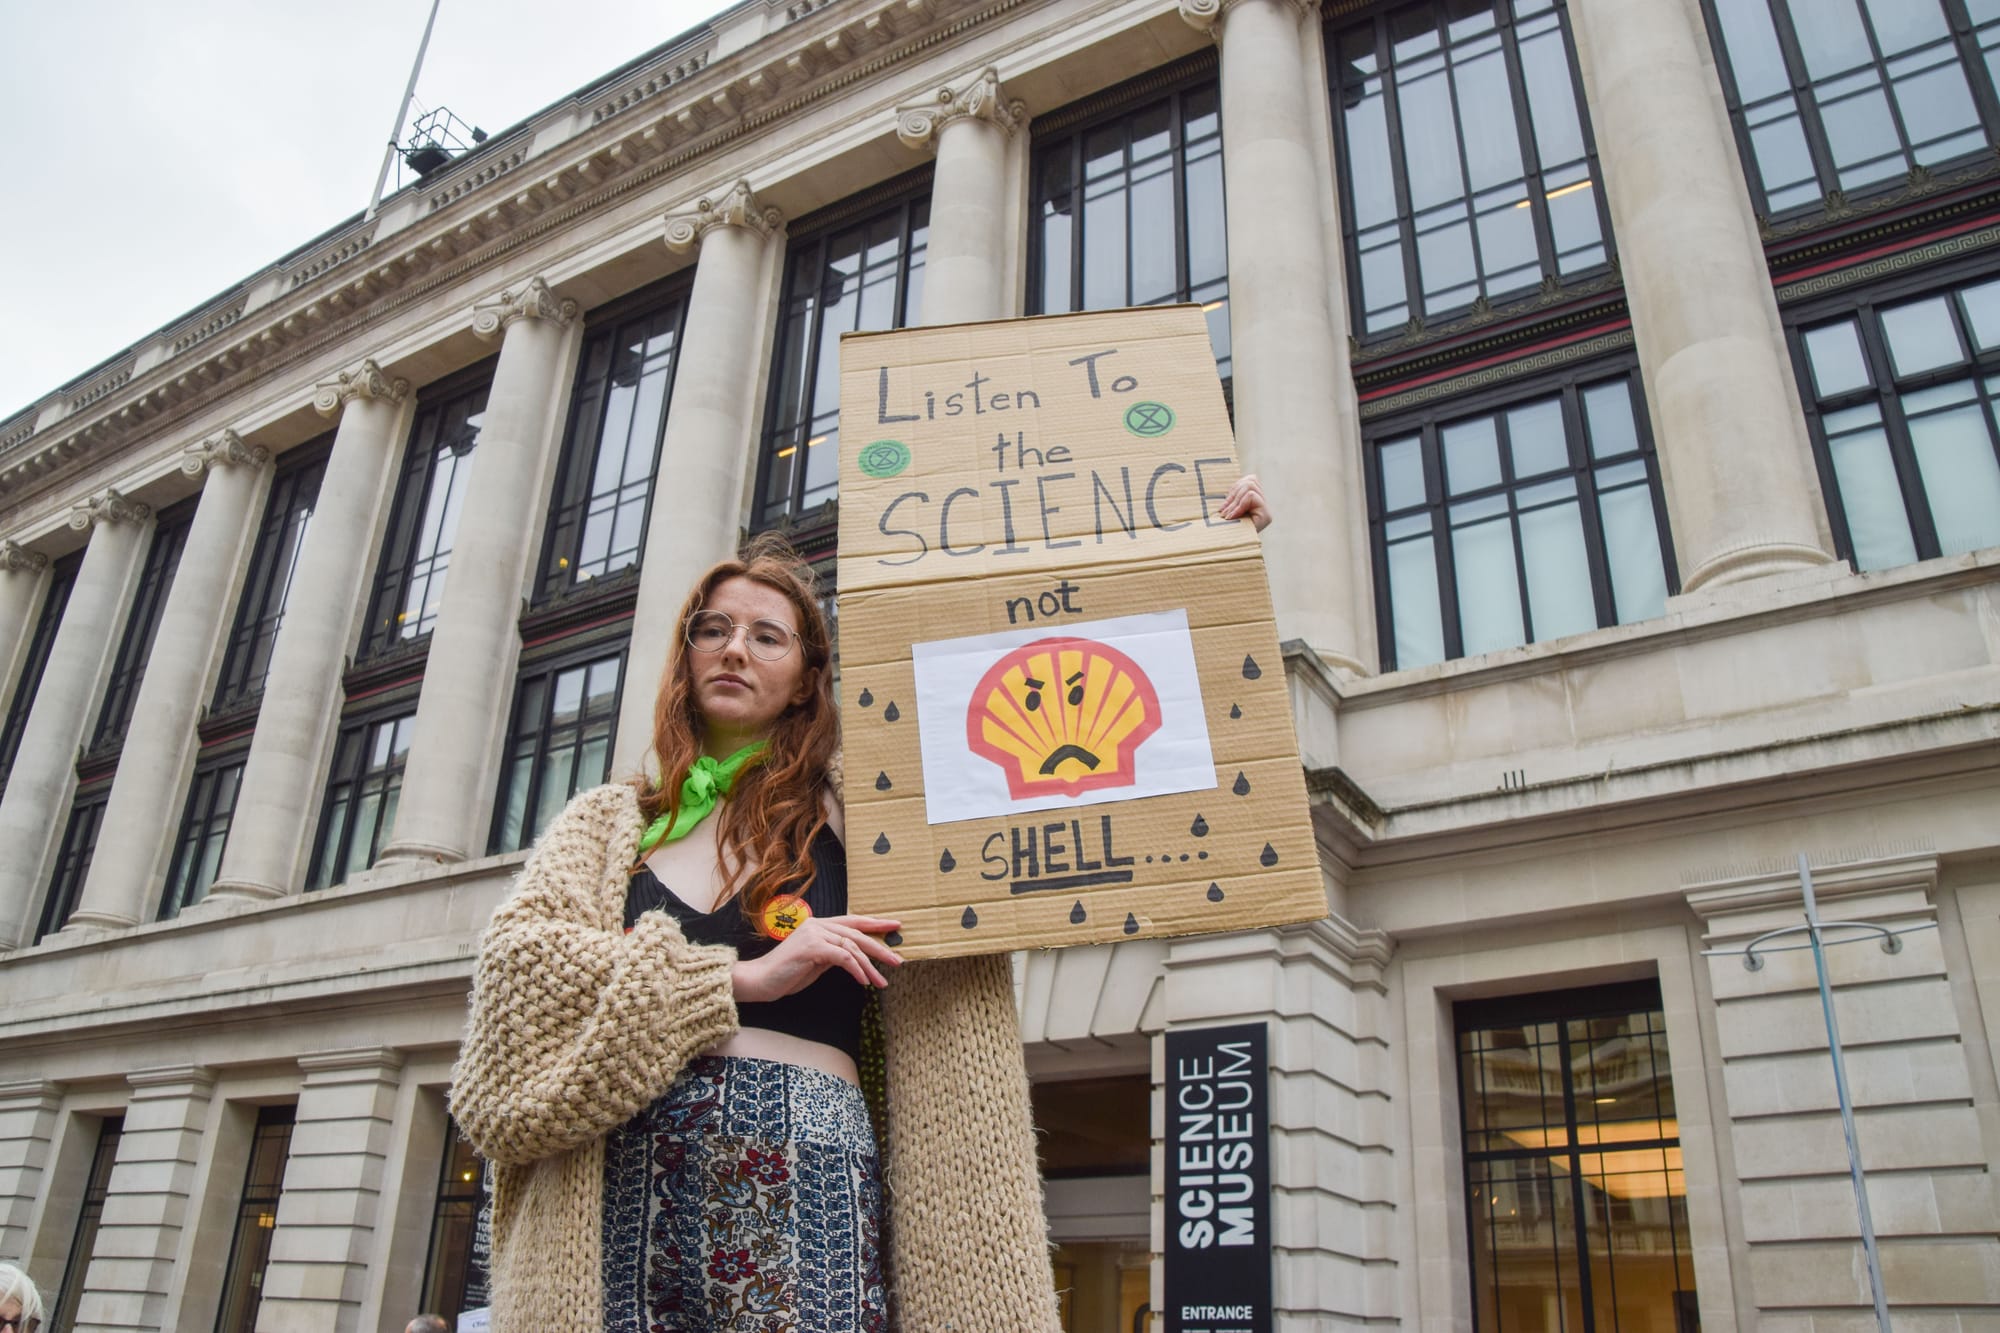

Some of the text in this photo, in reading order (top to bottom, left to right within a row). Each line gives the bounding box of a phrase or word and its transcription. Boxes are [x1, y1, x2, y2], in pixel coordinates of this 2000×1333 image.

[878, 349, 1138, 424] Listen To
[992, 431, 1073, 472] the
[877, 457, 1241, 566] SCIENCE
[1006, 581, 1082, 624] not
[1179, 1056, 1215, 1249] SCIENCE
[1217, 1041, 1255, 1247] MUSEUM
[1182, 1305, 1253, 1320] ENTRANCE
